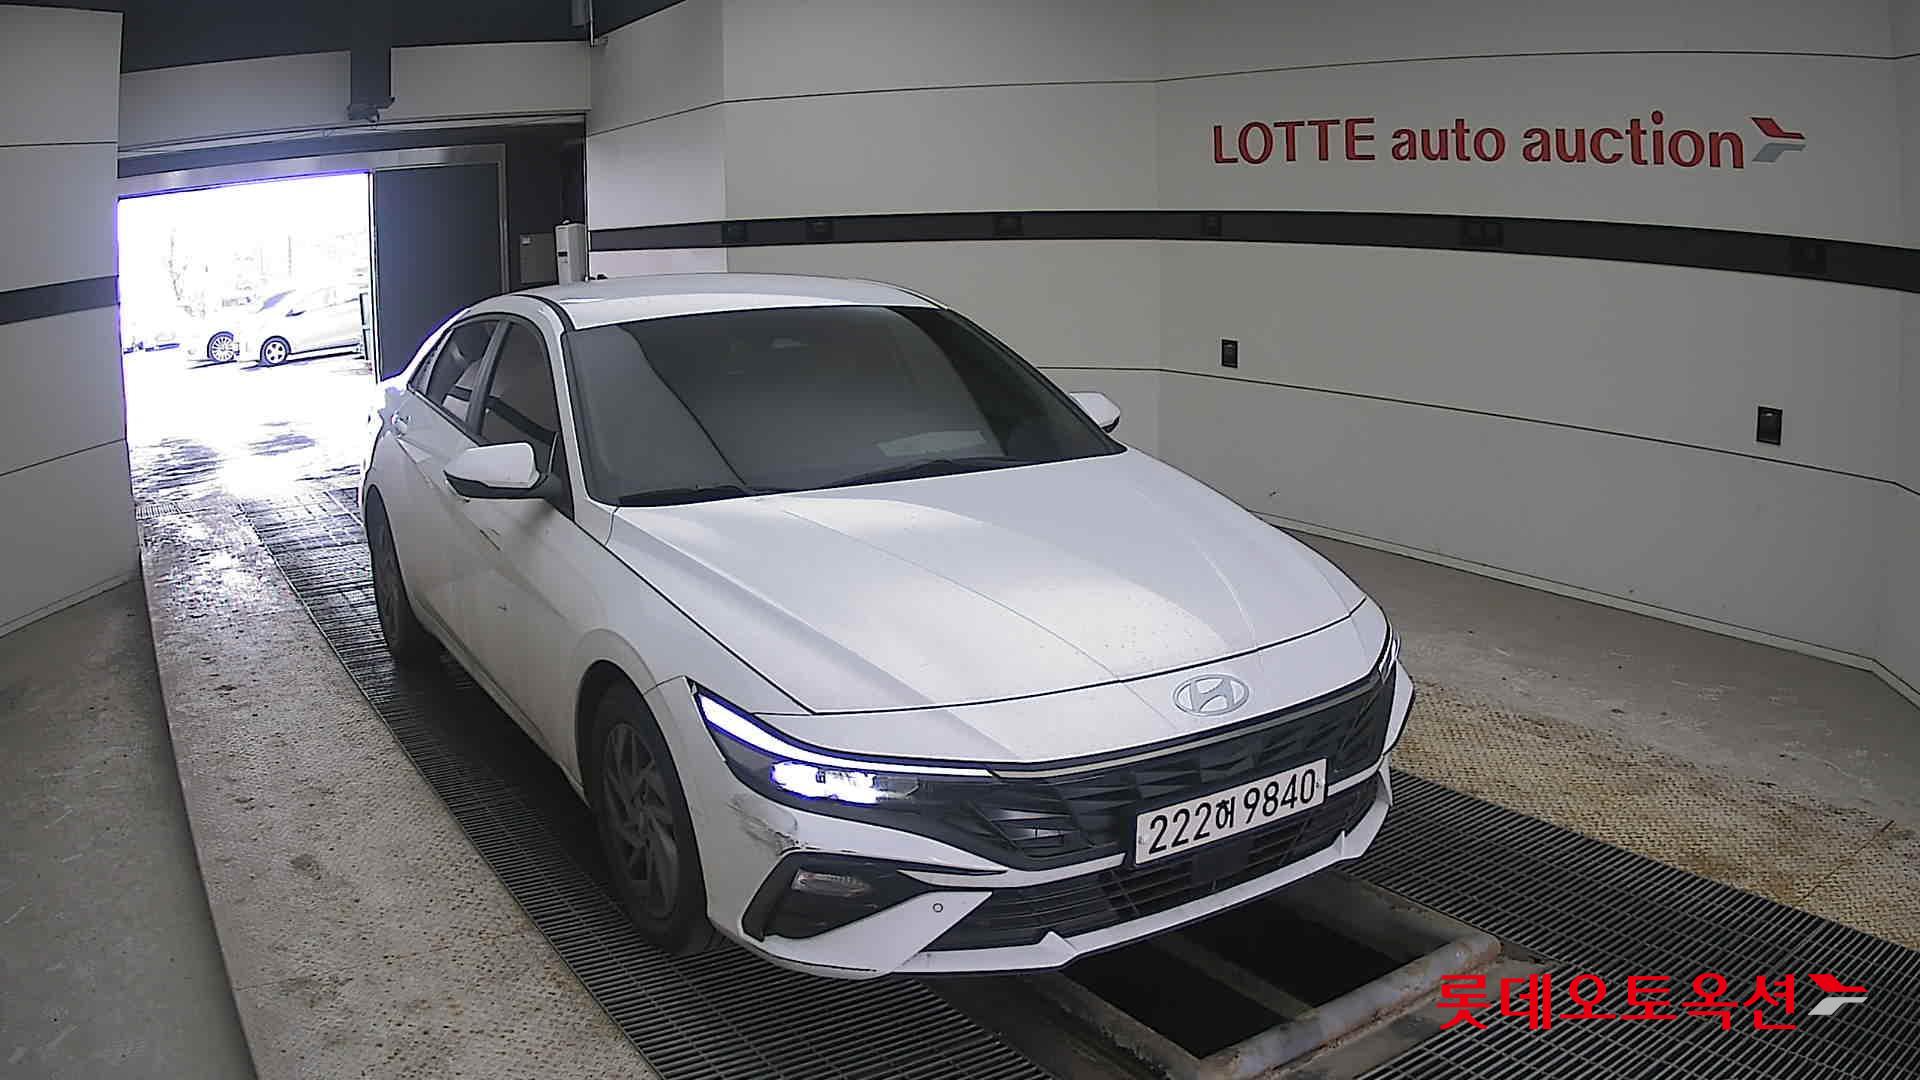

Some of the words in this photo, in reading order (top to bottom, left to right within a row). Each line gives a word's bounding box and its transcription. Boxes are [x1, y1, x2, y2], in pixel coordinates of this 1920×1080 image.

[1214, 117, 1375, 164] LOTTE
[1391, 117, 1506, 162] auto
[1522, 110, 1745, 169] auction
[1148, 797, 1236, 854] 222허
[1244, 769, 1316, 824] 9840
